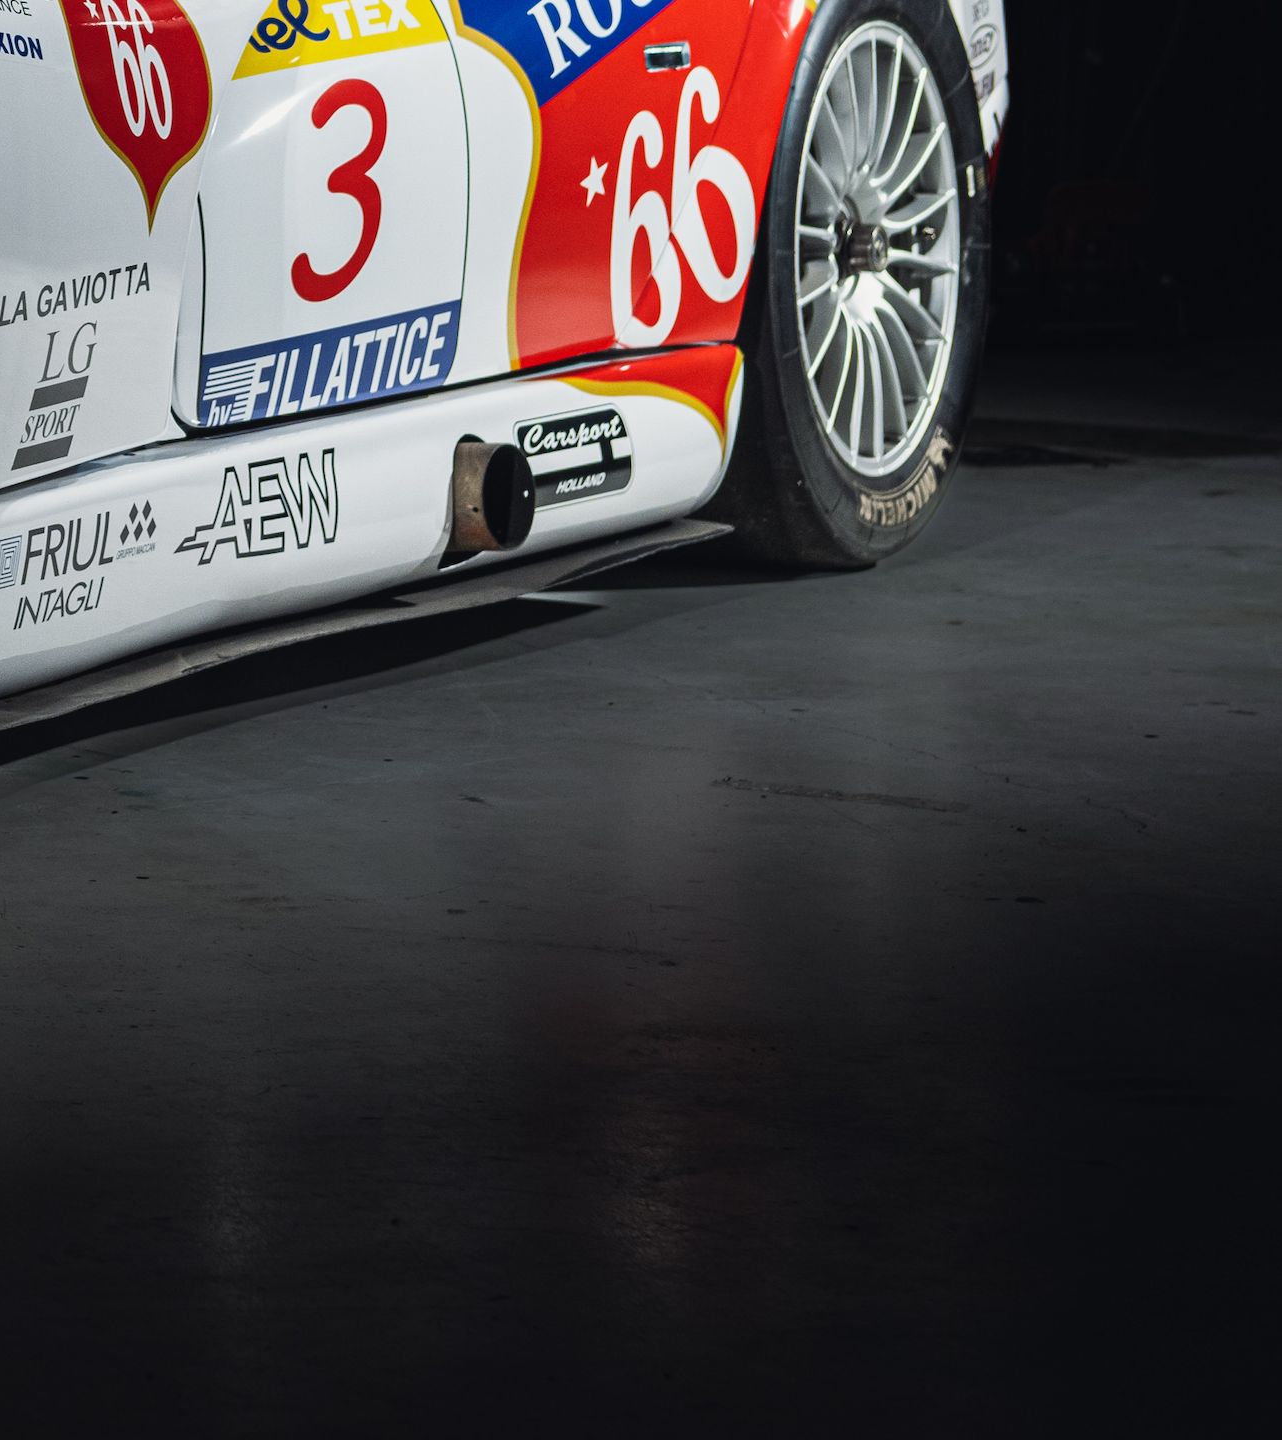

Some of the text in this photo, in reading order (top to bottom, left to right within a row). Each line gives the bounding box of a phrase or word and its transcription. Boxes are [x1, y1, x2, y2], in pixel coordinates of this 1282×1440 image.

[290, 78, 388, 303] 3
[610, 65, 756, 349] 66
[36, 262, 151, 319] GAVIOTTA
[39, 319, 98, 382] LG
[234, 310, 452, 422] FILLATTICE
[20, 404, 81, 445] SPORT
[523, 415, 623, 454] Carsport
[174, 448, 339, 566] AEW
[556, 472, 607, 495] HOLLAND
[859, 464, 937, 528] MICHELIN
[22, 511, 114, 586] FRIUL
[13, 577, 105, 631] INTAGLI
